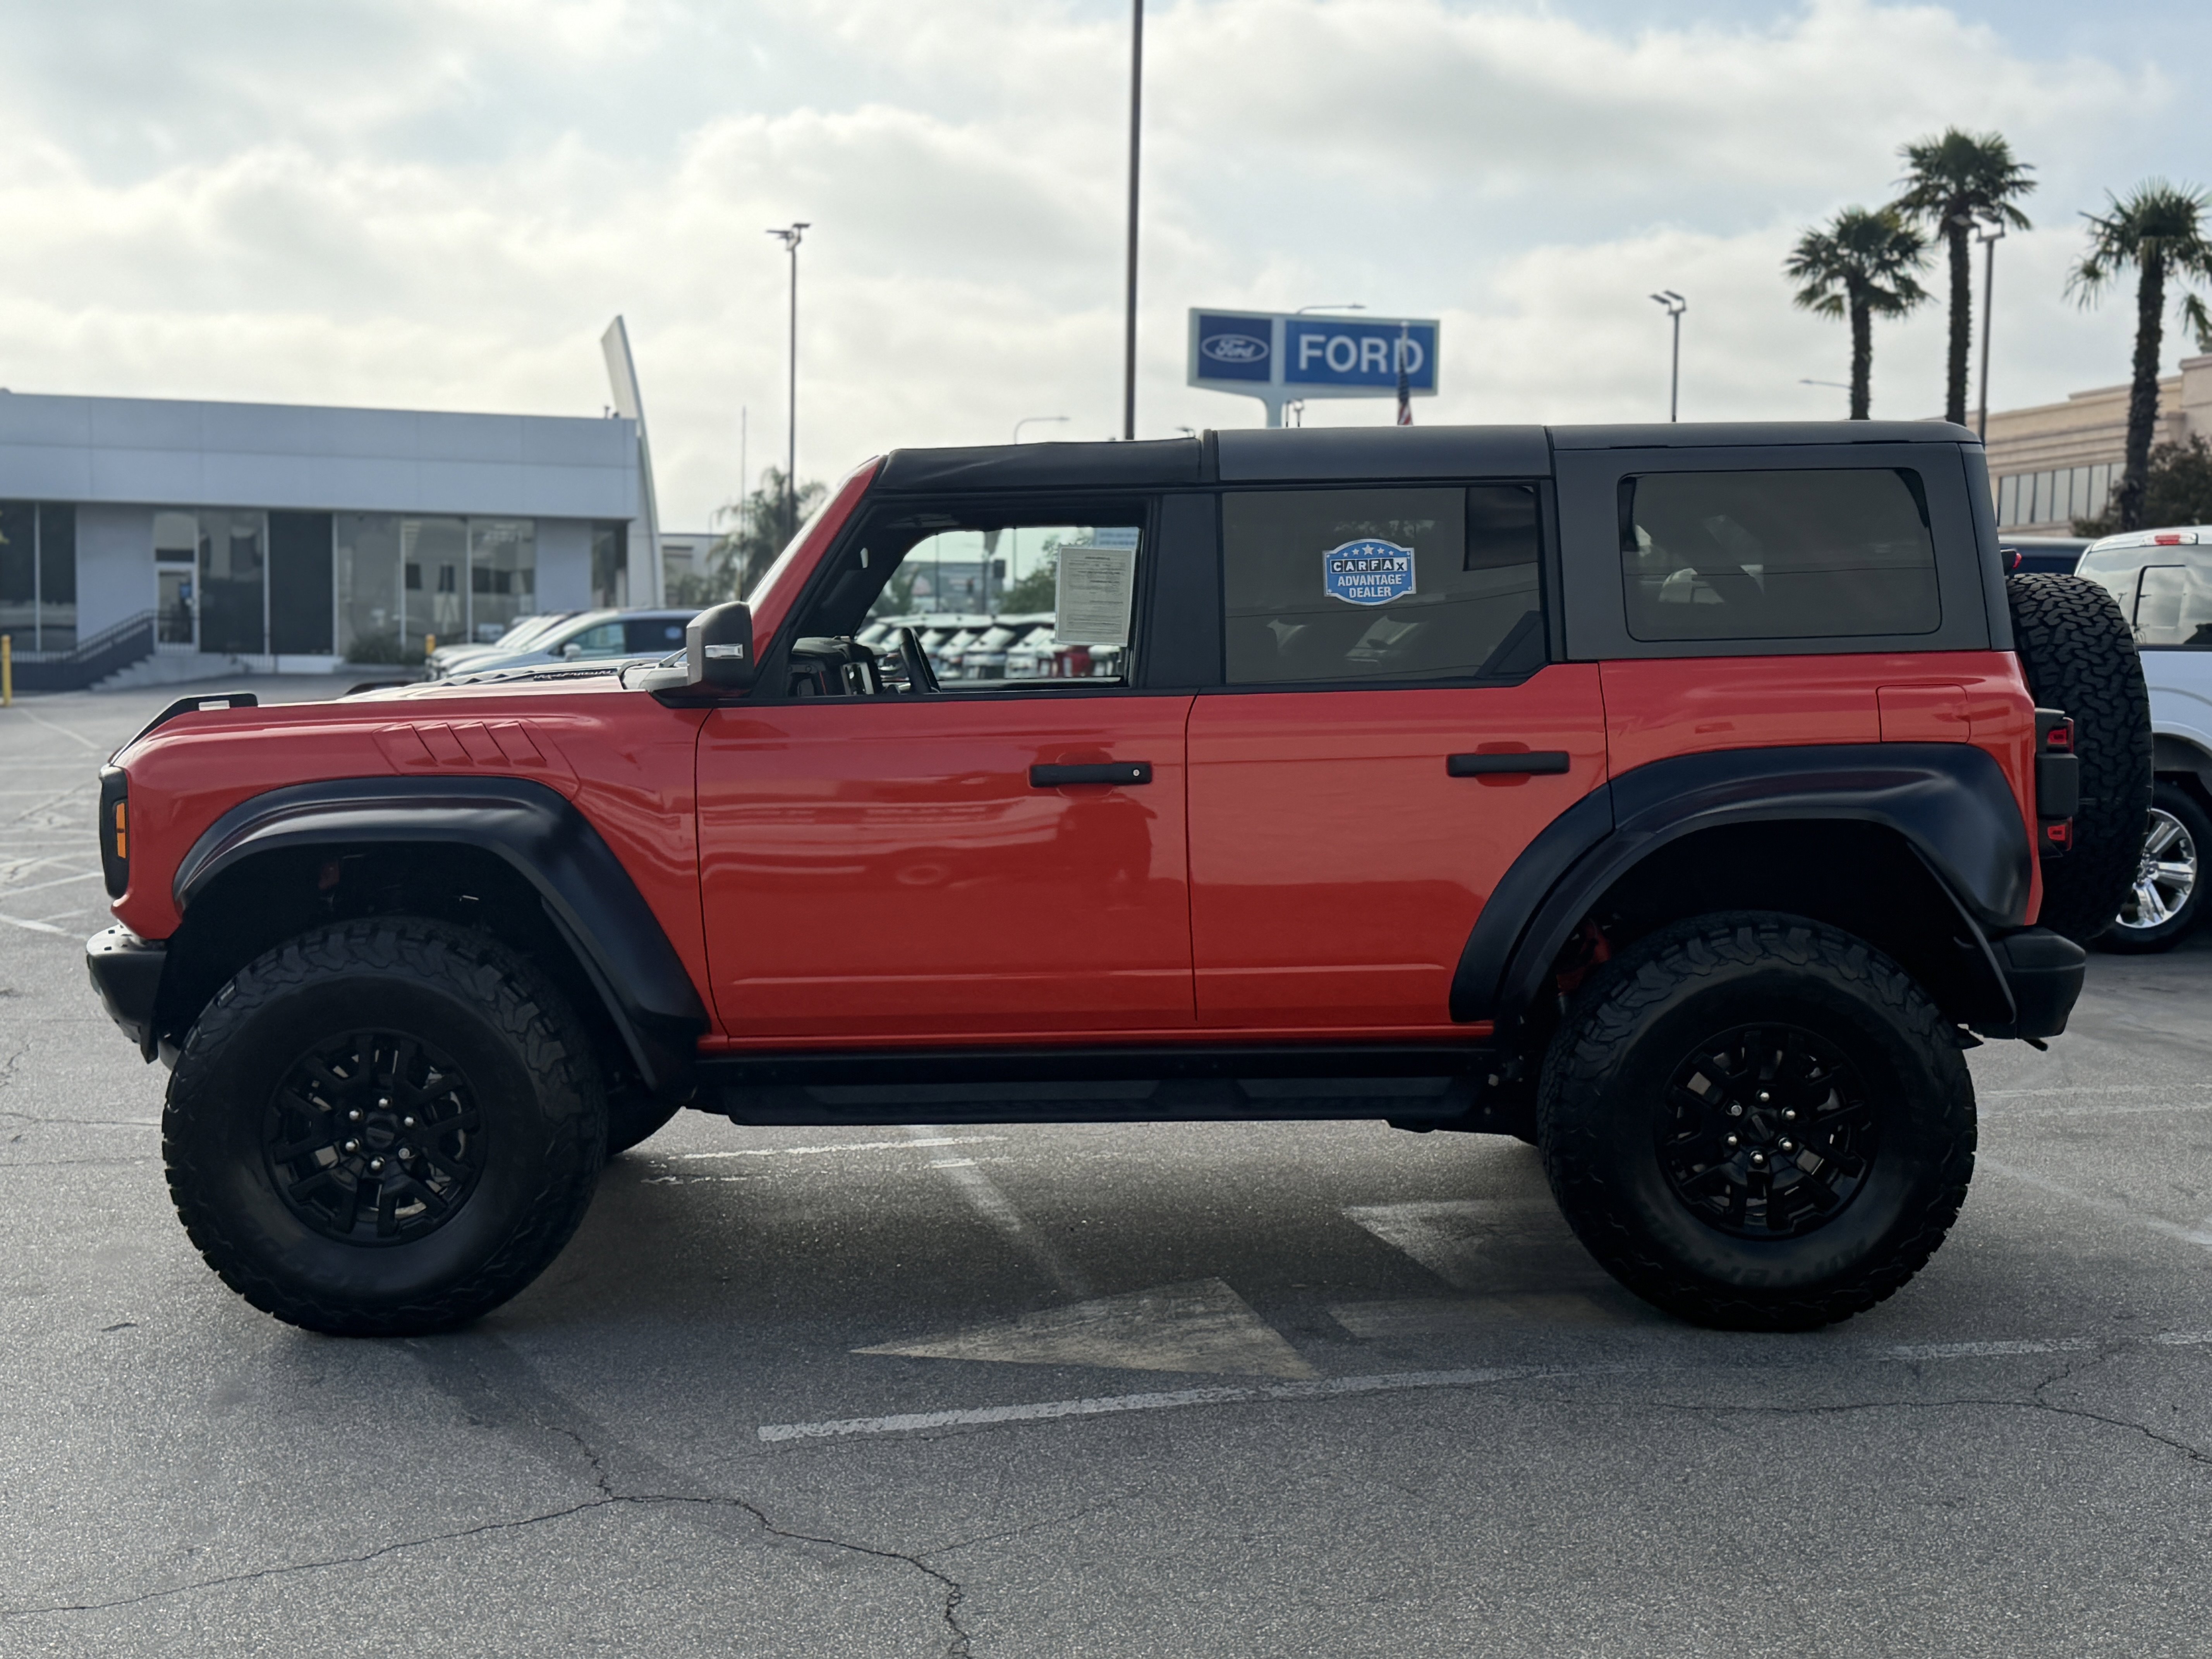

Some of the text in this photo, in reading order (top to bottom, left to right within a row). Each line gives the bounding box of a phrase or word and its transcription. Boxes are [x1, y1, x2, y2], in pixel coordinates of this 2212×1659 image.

[1215, 338, 1255, 357] Ford
[1299, 334, 1424, 373] FORD
[1333, 560, 1405, 572] CARFAX
[1338, 575, 1402, 586] ADVANTAGE
[1349, 586, 1392, 598] DEALER
